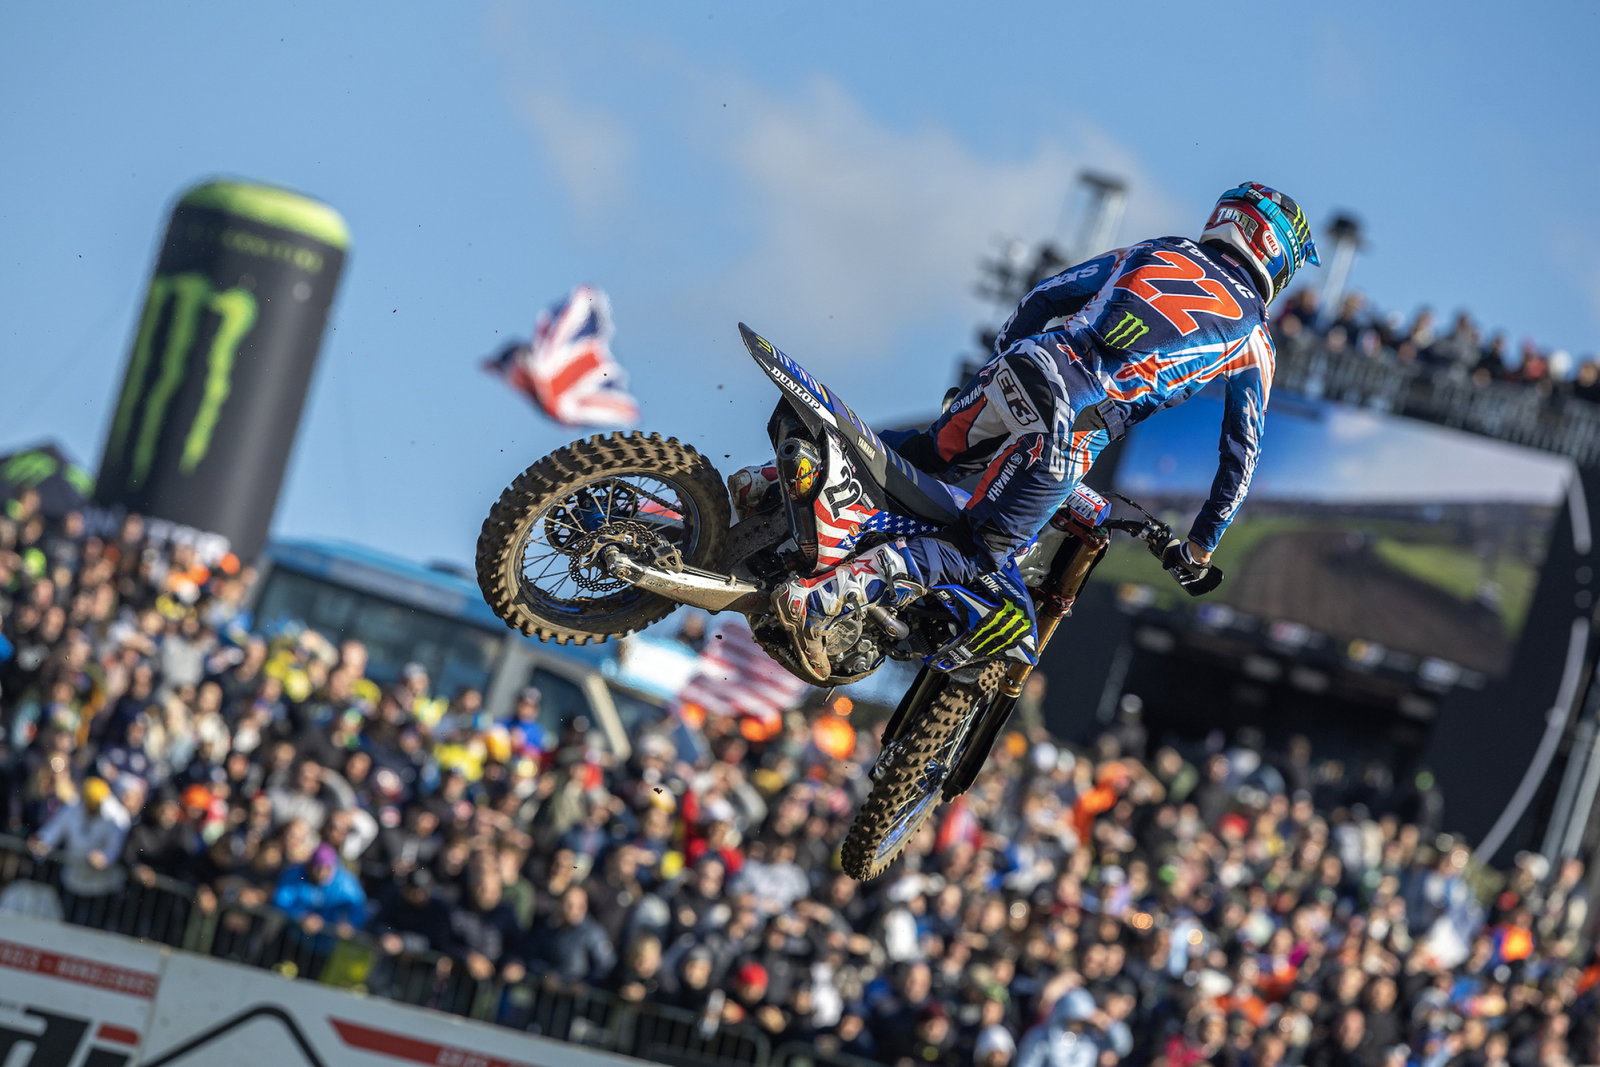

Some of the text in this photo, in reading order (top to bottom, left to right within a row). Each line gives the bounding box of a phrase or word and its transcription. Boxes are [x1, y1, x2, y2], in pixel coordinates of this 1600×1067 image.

[1265, 234, 1278, 254] BELL
[1286, 230, 1302, 268] OAKLE
[1113, 251, 1243, 336] 22
[771, 365, 822, 410] DUNLOP
[998, 370, 1039, 426] ET3
[823, 465, 863, 523] 22
[986, 463, 1020, 503] YAMAHA
[979, 574, 1003, 594] SSIVE
